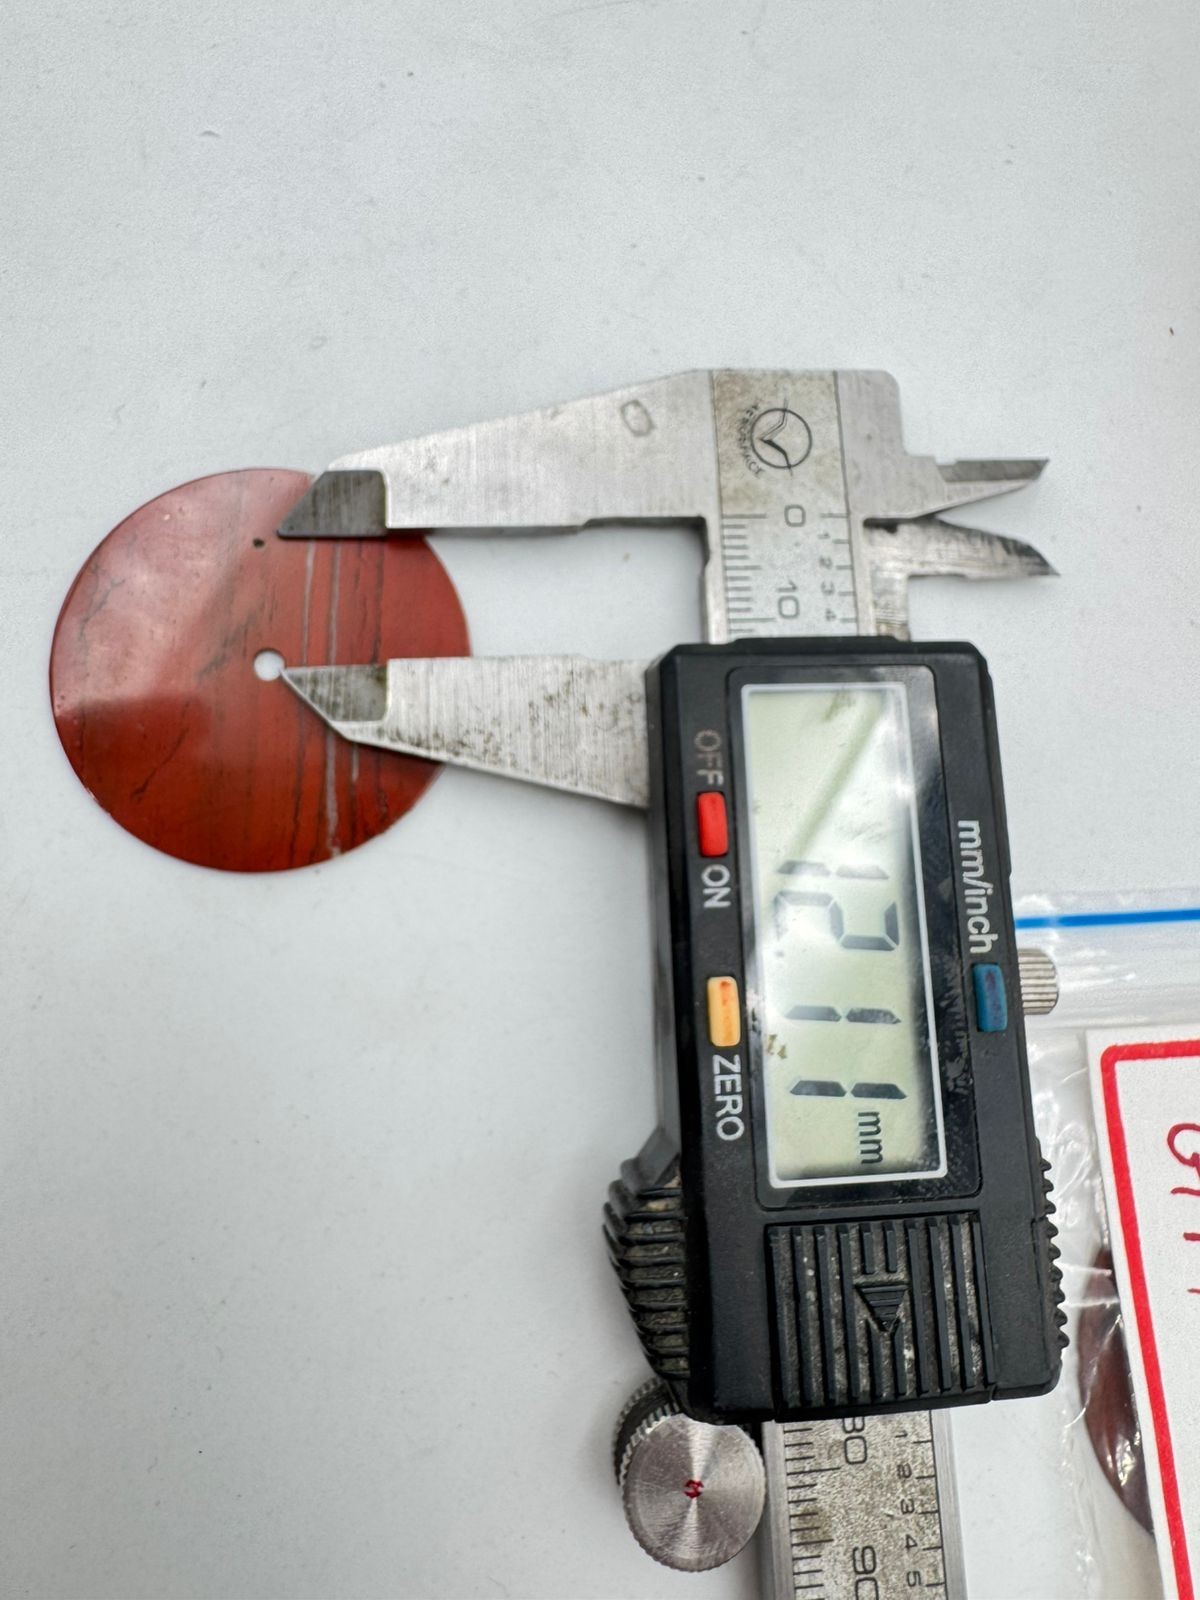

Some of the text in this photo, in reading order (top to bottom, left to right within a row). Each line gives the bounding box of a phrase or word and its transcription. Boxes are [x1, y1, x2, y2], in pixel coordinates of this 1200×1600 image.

[775, 504, 806, 619] 0 10
[694, 729, 725, 787] OFF
[701, 864, 732, 909] ON
[957, 819, 999, 954] mm/inch
[712, 1054, 745, 1141] ZERO
[857, 1110, 884, 1165] mm
[900, 1499, 915, 1515] 3
[905, 1534, 918, 1551] 4
[853, 1545, 879, 1600] 90
[906, 1570, 922, 1588] 5
